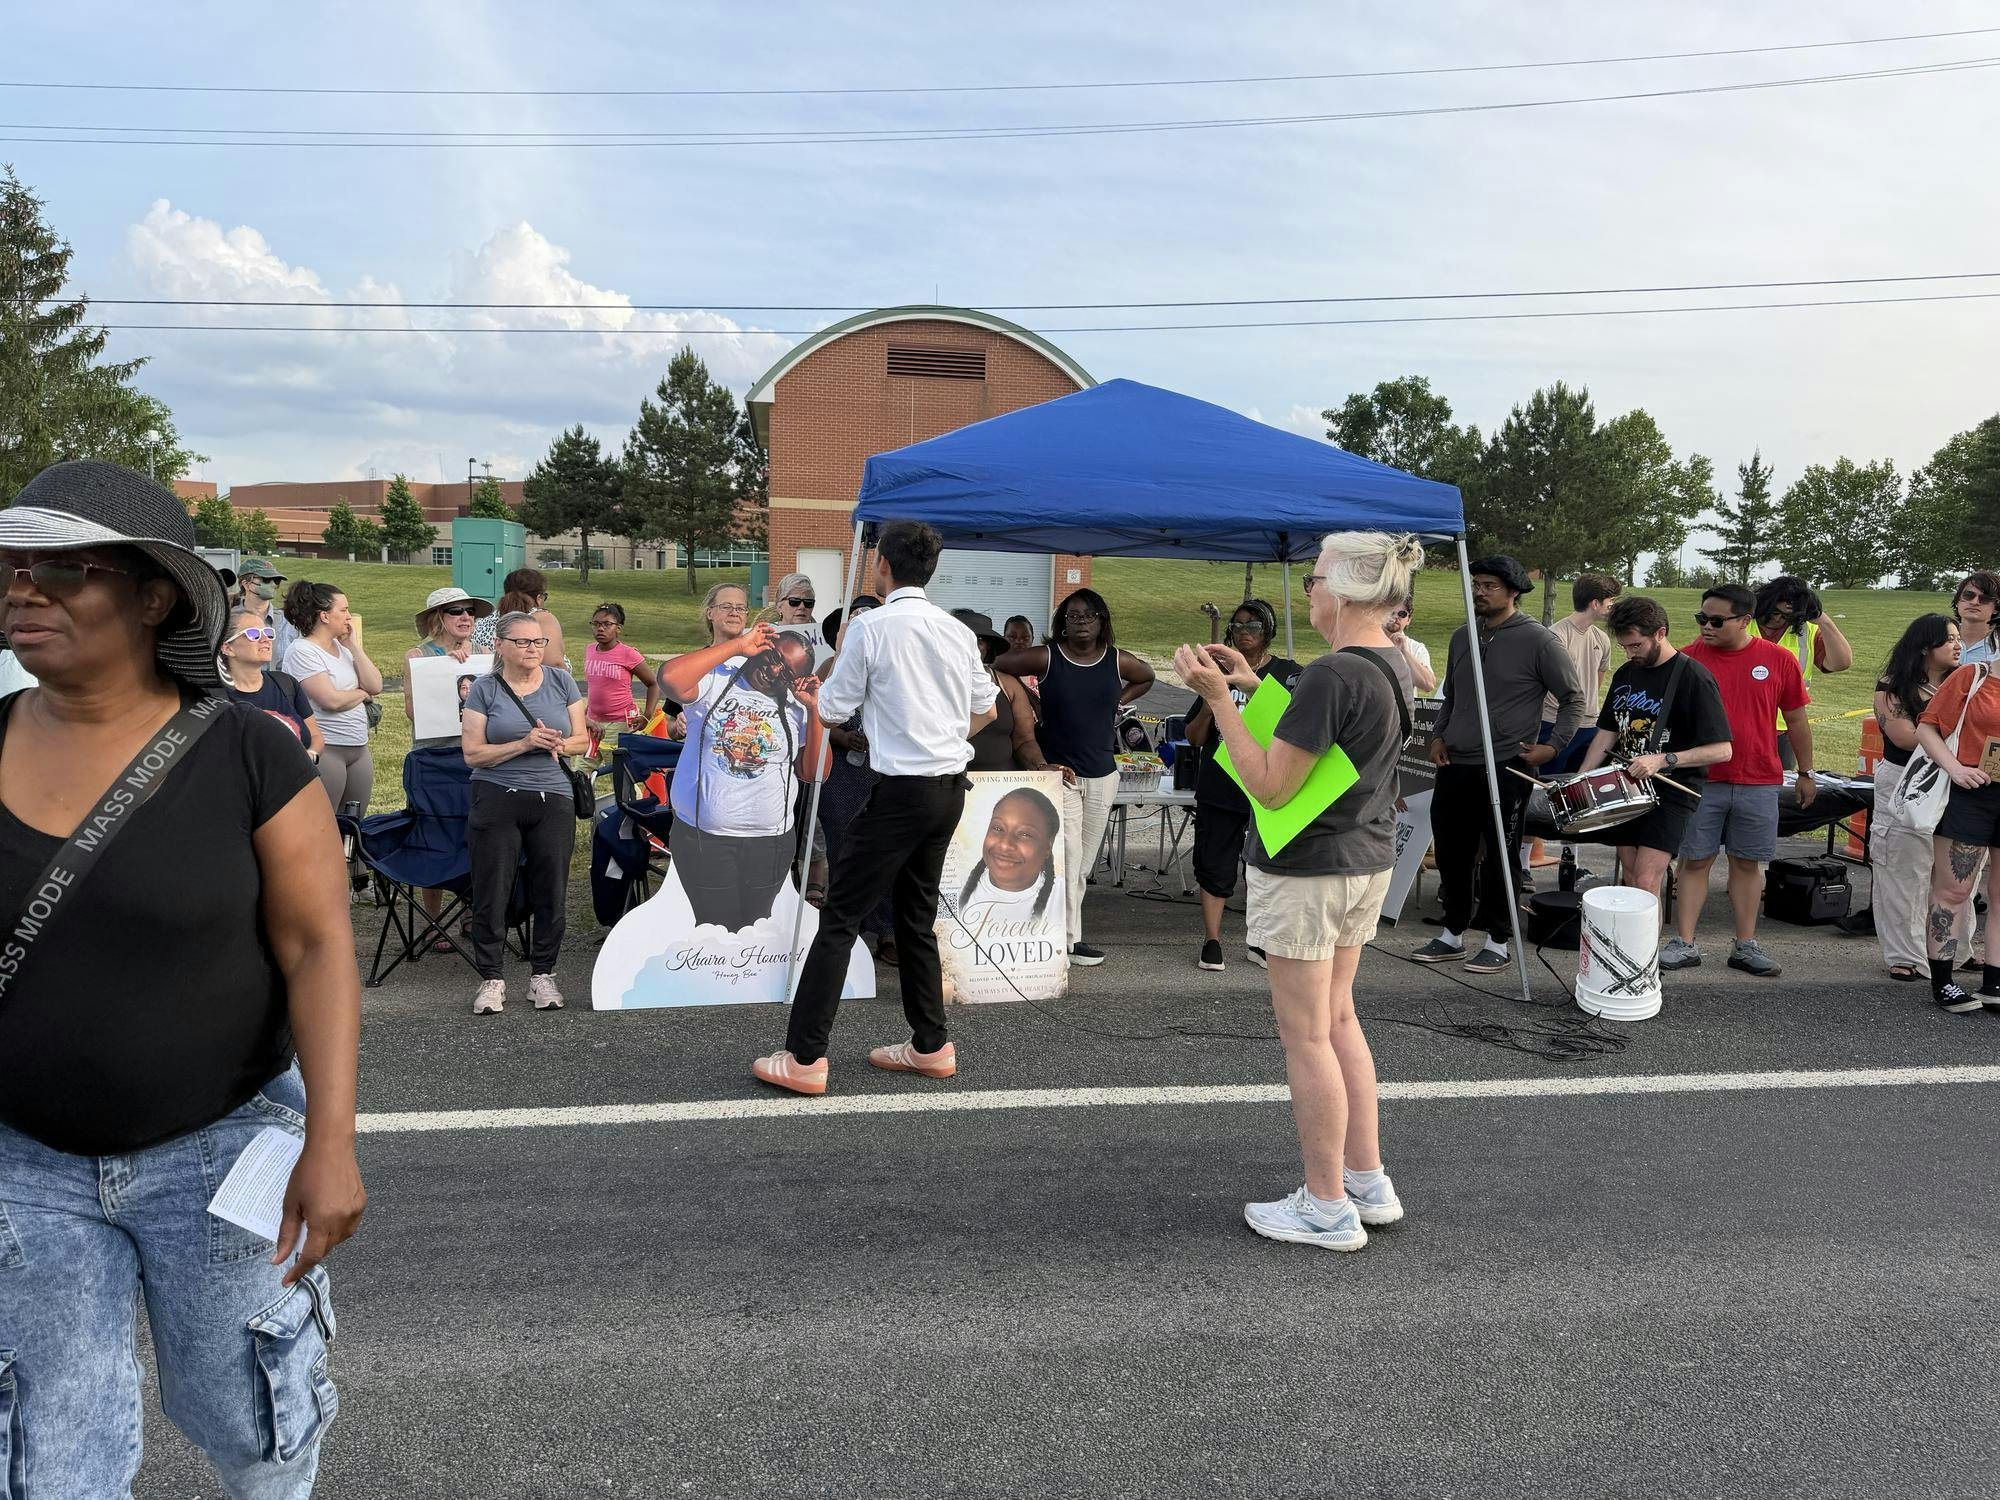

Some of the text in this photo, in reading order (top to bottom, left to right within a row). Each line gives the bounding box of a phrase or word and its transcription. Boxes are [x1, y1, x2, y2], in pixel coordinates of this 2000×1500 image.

[585, 660, 622, 681] AMPION
[1612, 685, 1664, 715] Detroi
[75, 728, 188, 852] MASS MODE
[0, 866, 76, 998] ASS MODE
[949, 898, 1053, 950] Forever
[665, 946, 728, 971] Khaira
[974, 940, 1053, 966] LOVED
